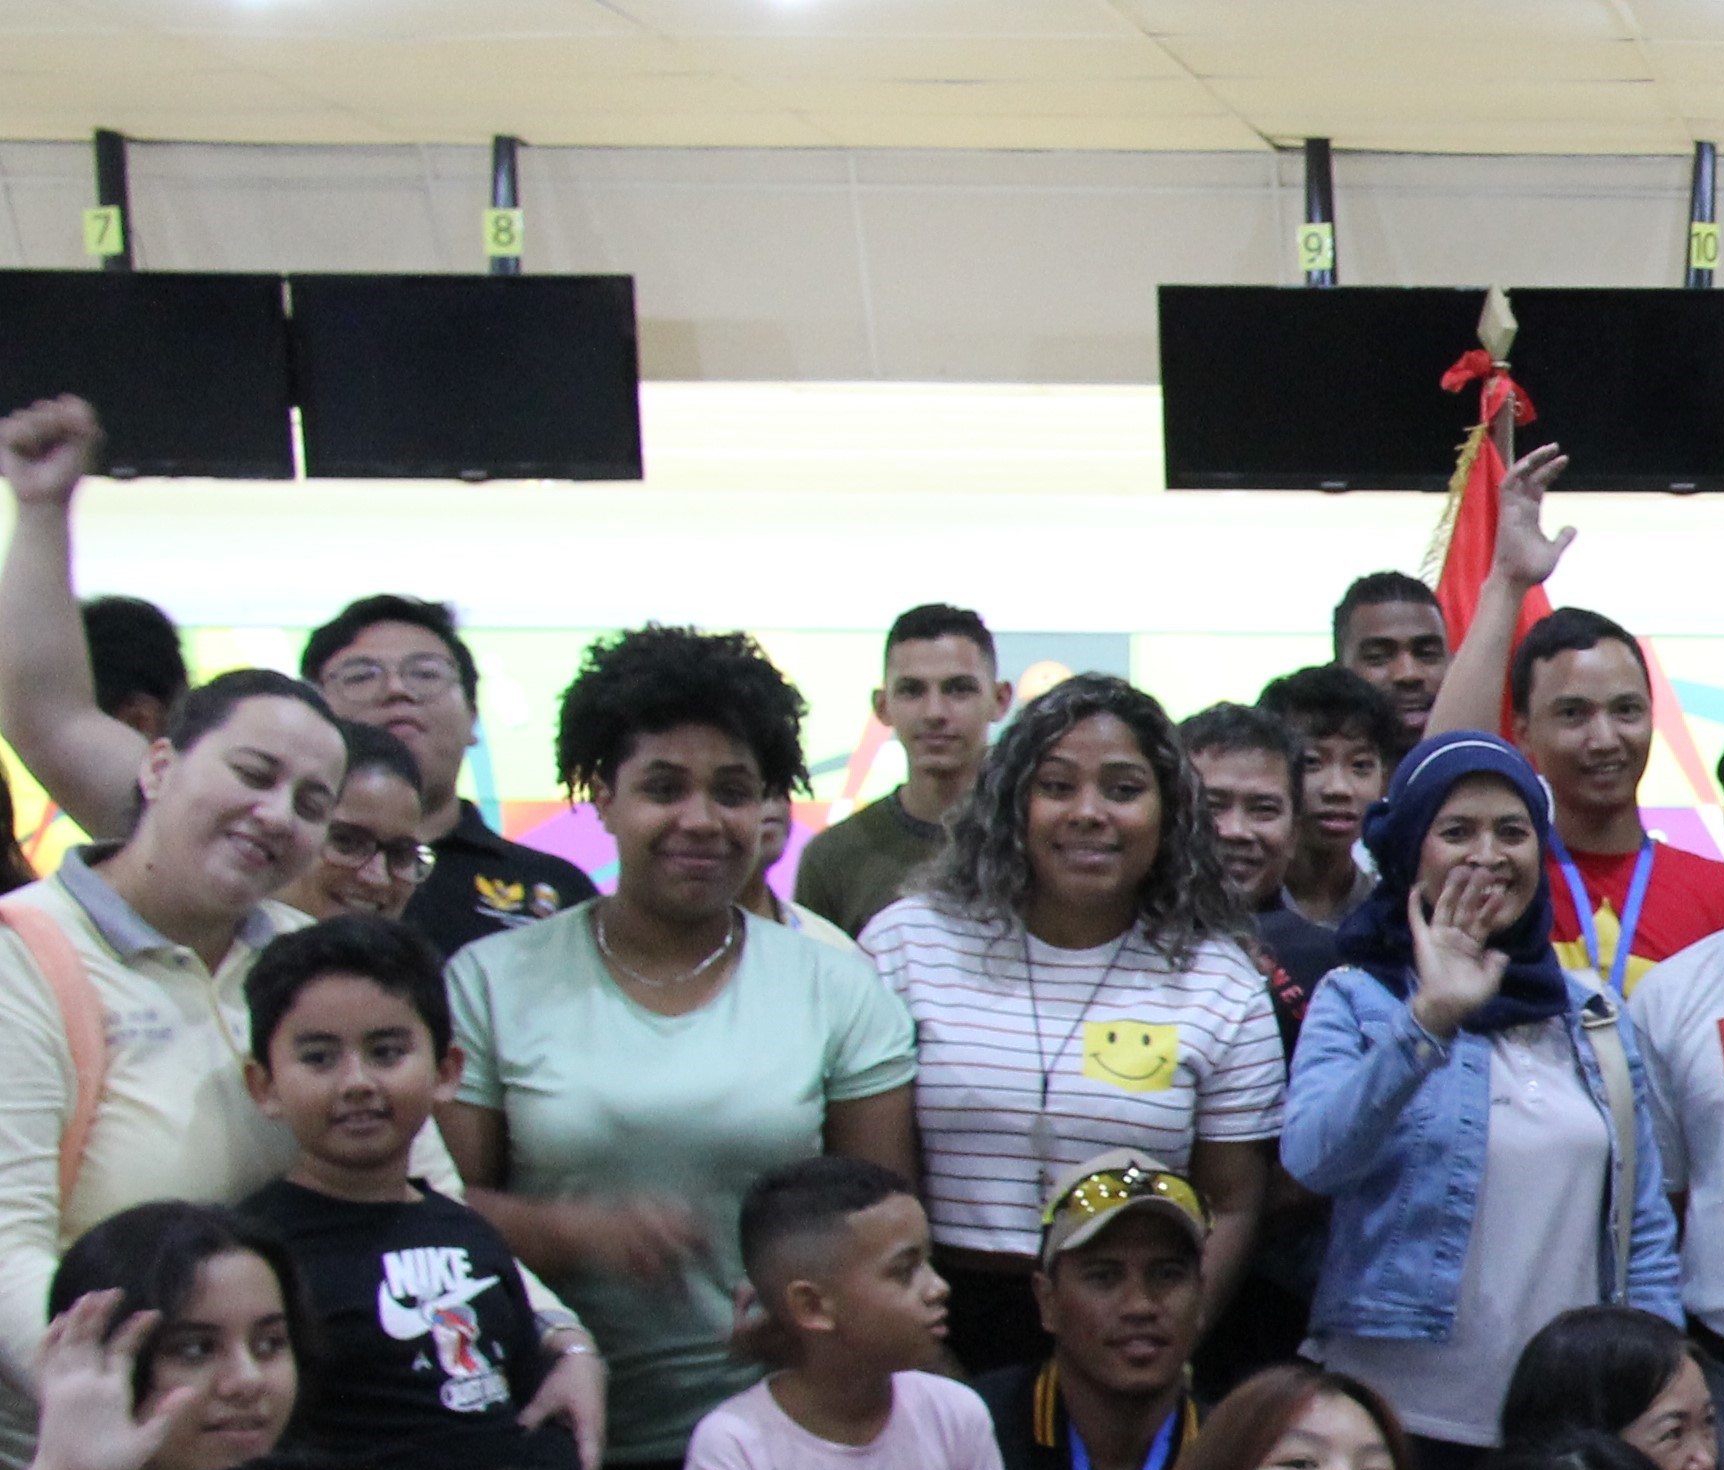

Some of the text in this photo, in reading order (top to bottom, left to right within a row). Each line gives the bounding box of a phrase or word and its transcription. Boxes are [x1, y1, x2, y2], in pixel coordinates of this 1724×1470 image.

[92, 213, 111, 245] 7
[494, 216, 515, 247] 8
[1303, 232, 1324, 263] 9
[1693, 231, 1719, 263] 10
[382, 1247, 473, 1299] NIKE
